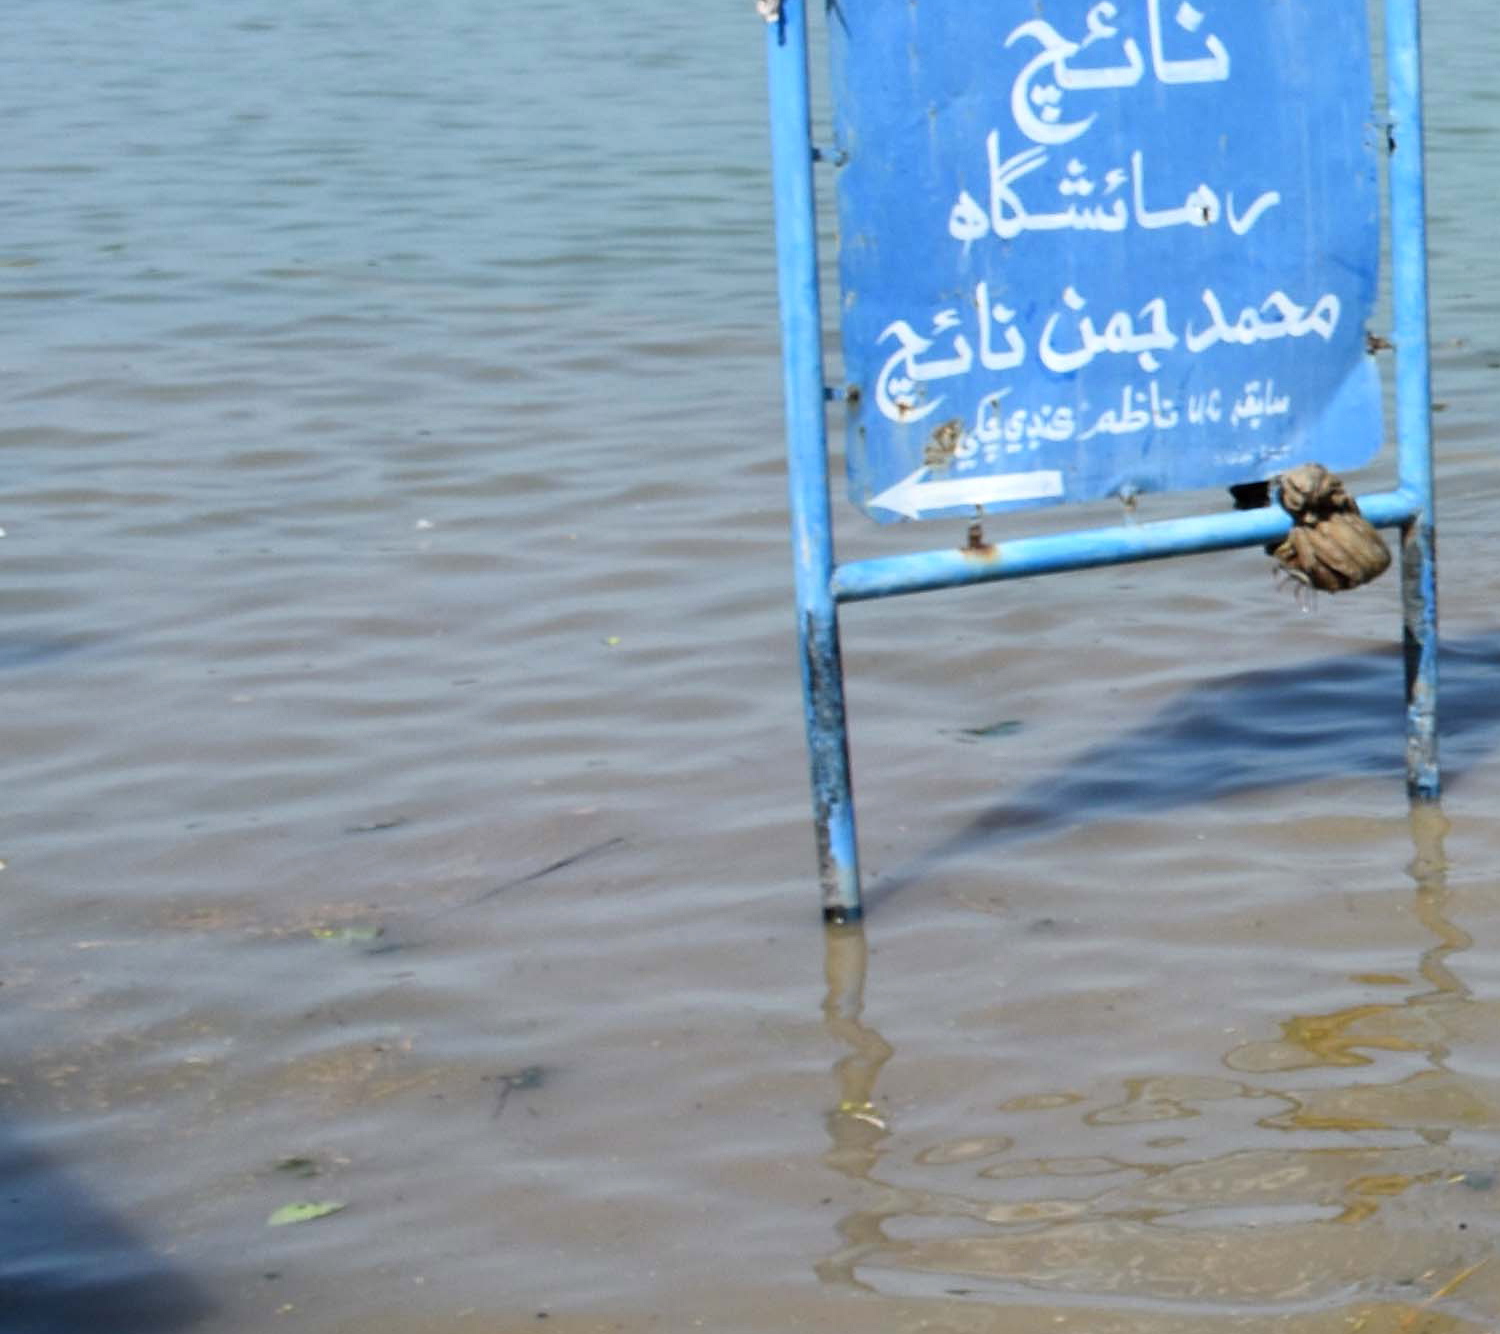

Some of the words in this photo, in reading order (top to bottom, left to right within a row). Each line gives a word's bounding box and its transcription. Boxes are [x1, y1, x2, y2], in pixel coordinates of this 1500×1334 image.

[1038, 285, 1179, 374] جمن
[1185, 288, 1341, 353] محمد
[1076, 379, 1180, 441] ناظم
